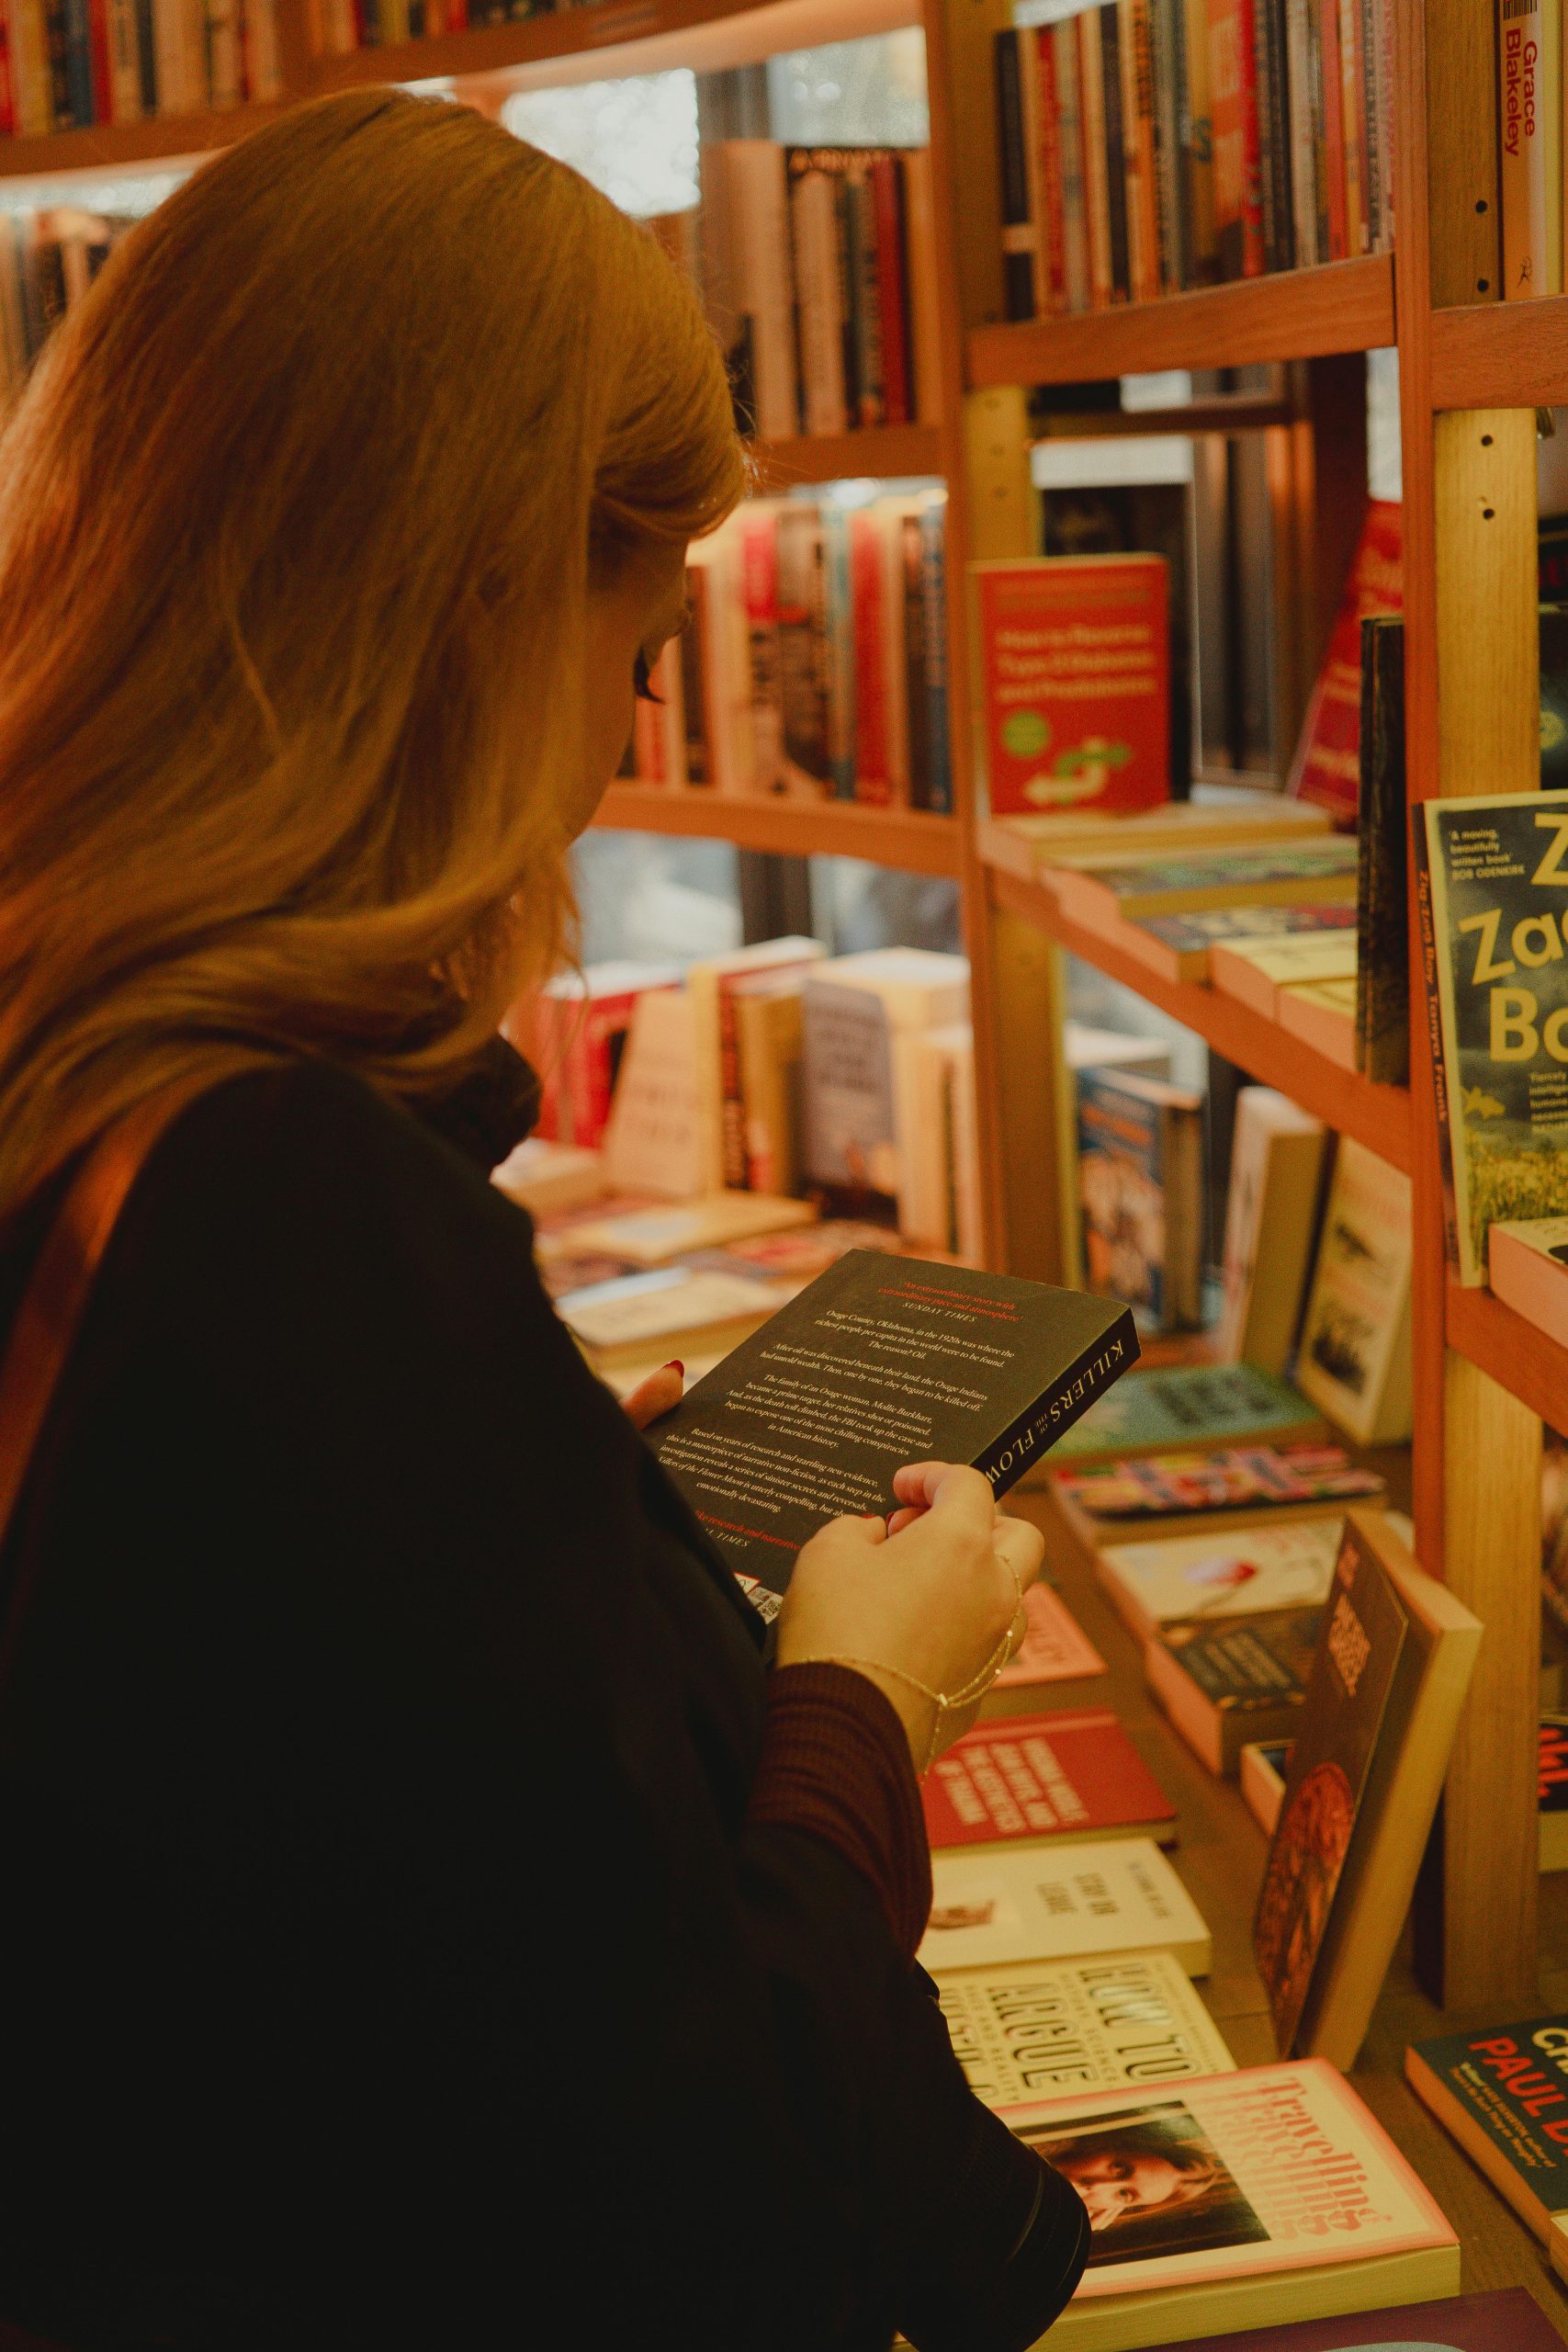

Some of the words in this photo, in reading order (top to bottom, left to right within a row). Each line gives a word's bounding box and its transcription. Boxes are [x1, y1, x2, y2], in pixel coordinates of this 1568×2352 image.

[1504, 28, 1521, 156] Blakeley
[1523, 40, 1538, 137] Grace
[1459, 908, 1568, 986] Za
[814, 1318, 840, 1329] richest
[836, 1324, 863, 1333] people
[874, 1332, 898, 1341] capita
[900, 1338, 919, 1346] the
[919, 1341, 943, 1351] world
[942, 1347, 961, 1356] were
[968, 1352, 980, 1361] be
[826, 1310, 849, 1320] Osage
[923, 1330, 938, 1339] the
[938, 1333, 962, 1344] 1920s
[962, 1340, 977, 1349] was
[977, 1344, 1001, 1355] where
[1000, 1350, 1015, 1358] the
[902, 1302, 944, 1315] SUNDAY
[944, 1310, 977, 1322] TIMES
[773, 1343, 794, 1352] After
[816, 1351, 857, 1366] discovered
[853, 1360, 885, 1373] beneath
[883, 1367, 903, 1377] their
[920, 1377, 935, 1385] the
[934, 1381, 960, 1393] Osage
[958, 1386, 988, 1401] Indians
[868, 1340, 884, 1350] The
[745, 1381, 773, 1394] became
[774, 1390, 800, 1399] prime
[821, 1399, 837, 1408] her
[835, 1405, 867, 1417] relatives
[867, 1412, 885, 1422] shot
[759, 1351, 777, 1360] had
[773, 1355, 799, 1364] untold
[857, 1373, 869, 1382] by
[884, 1379, 902, 1390] they
[900, 1383, 925, 1396] began
[933, 1392, 945, 1401] be
[943, 1395, 969, 1408] killed
[763, 1374, 779, 1383] The
[776, 1377, 801, 1389] family
[819, 1387, 842, 1399] Osage
[871, 1400, 897, 1413] Mollie
[1050, 1339, 1124, 1422] KILLERS
[724, 1399, 747, 1411] began
[754, 1408, 780, 1419] expose
[801, 1419, 816, 1429] the
[814, 1424, 835, 1433] most
[833, 1429, 863, 1443] chilling
[862, 1438, 910, 1456] conspiracies
[751, 1395, 765, 1403] the
[763, 1397, 785, 1408] death
[828, 1414, 842, 1423] the
[840, 1417, 858, 1427] FBI
[854, 1422, 874, 1432] took
[873, 1428, 886, 1437] up
[884, 1430, 898, 1439] the
[897, 1435, 917, 1444] case
[915, 1441, 933, 1450] and
[767, 1422, 777, 1430] in
[775, 1425, 813, 1441] American
[660, 1444, 705, 1462] investigation
[703, 1457, 728, 1468] reveals
[734, 1466, 756, 1476] series
[764, 1474, 793, 1487] sinister
[790, 1483, 817, 1495] secrets
[817, 1491, 835, 1500] and
[665, 1434, 680, 1442] this
[691, 1442, 738, 1458] masterpiece
[741, 1455, 776, 1469] narrative
[827, 1480, 846, 1490] each
[846, 1486, 863, 1497] step
[862, 1489, 873, 1498] in
[871, 1493, 886, 1503] the
[691, 1428, 716, 1439] Based
[719, 1437, 741, 1446] years
[750, 1444, 782, 1457] research
[780, 1453, 798, 1462] and
[795, 1457, 829, 1473] startling
[826, 1466, 845, 1476] new
[986, 1429, 1035, 1484] FLOW
[695, 1482, 738, 1500] emotionally
[1078, 1963, 1173, 2027] HOW
[989, 1983, 1100, 2088] ARGUE
[1118, 2035, 1201, 2080] TO
[1469, 2036, 1566, 2118] PAUL
